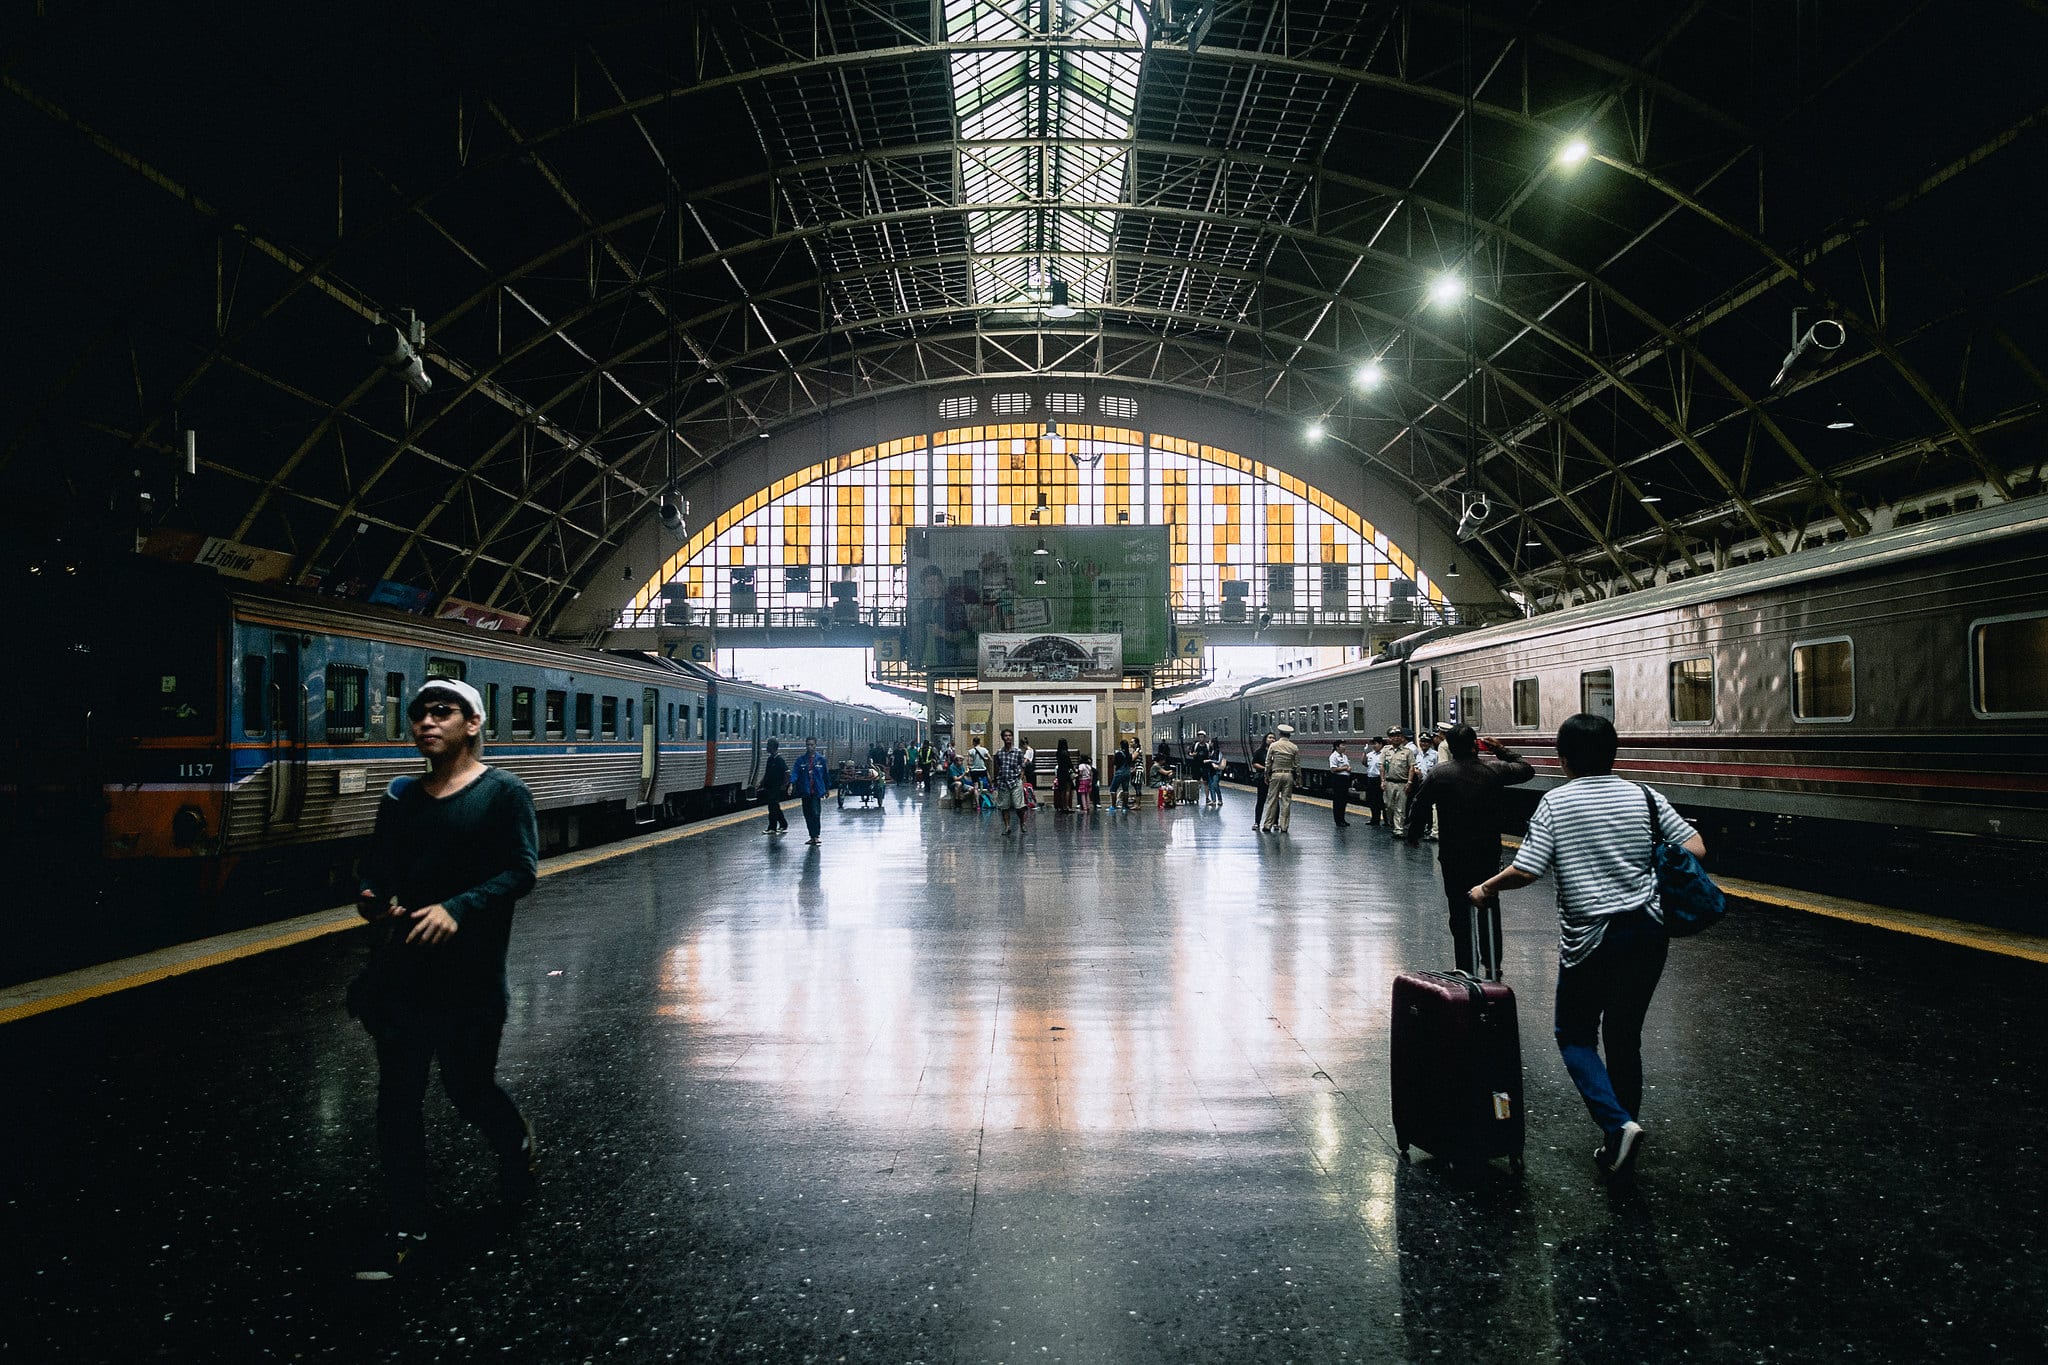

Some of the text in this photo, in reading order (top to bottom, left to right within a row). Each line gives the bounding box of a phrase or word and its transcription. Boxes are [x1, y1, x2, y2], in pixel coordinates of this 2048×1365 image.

[664, 643, 704, 660] 7 6
[882, 641, 893, 657] 5
[1184, 639, 1198, 654] 4
[1032, 704, 1078, 717] กรุงเทพ
[179, 763, 213, 776] 1137
